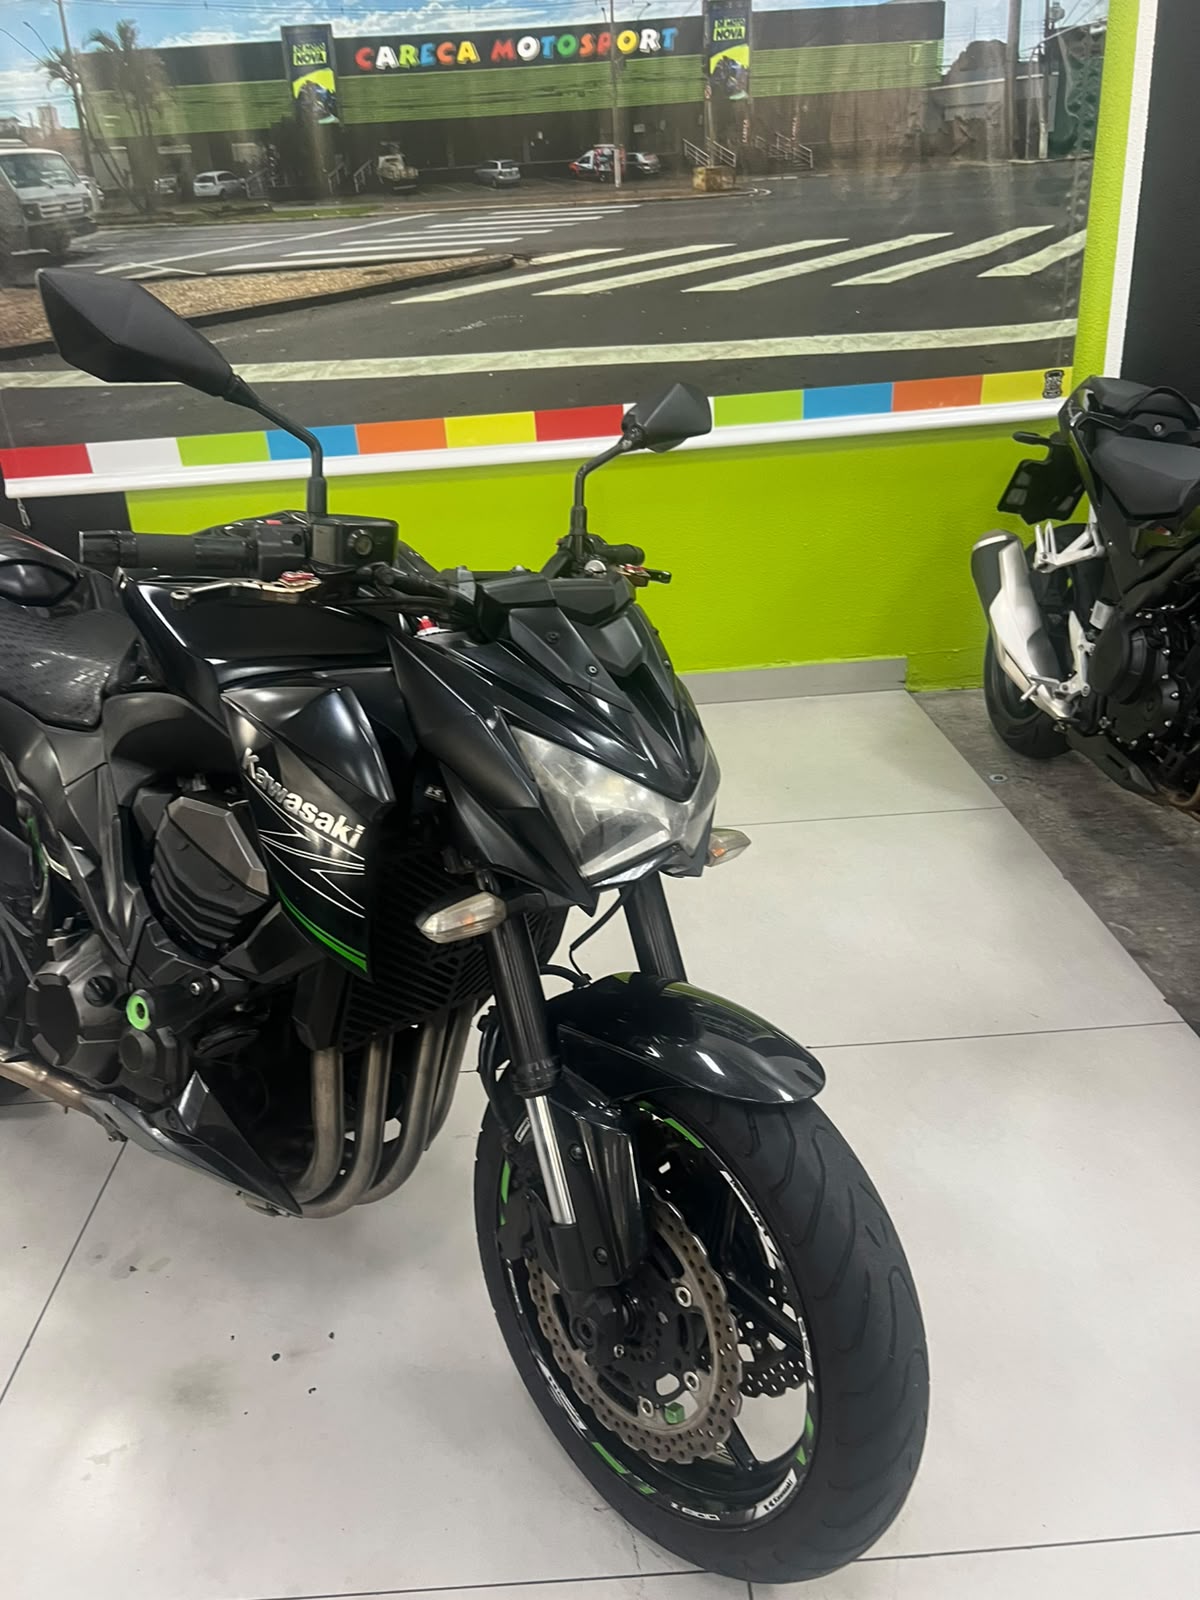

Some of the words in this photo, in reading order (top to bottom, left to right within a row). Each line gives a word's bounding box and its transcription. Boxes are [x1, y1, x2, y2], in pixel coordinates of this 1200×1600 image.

[354, 41, 480, 70] CARECA
[490, 27, 678, 62] MOTOSPORT
[716, 28, 743, 40] NOVA
[242, 747, 366, 848] Kawasaki
